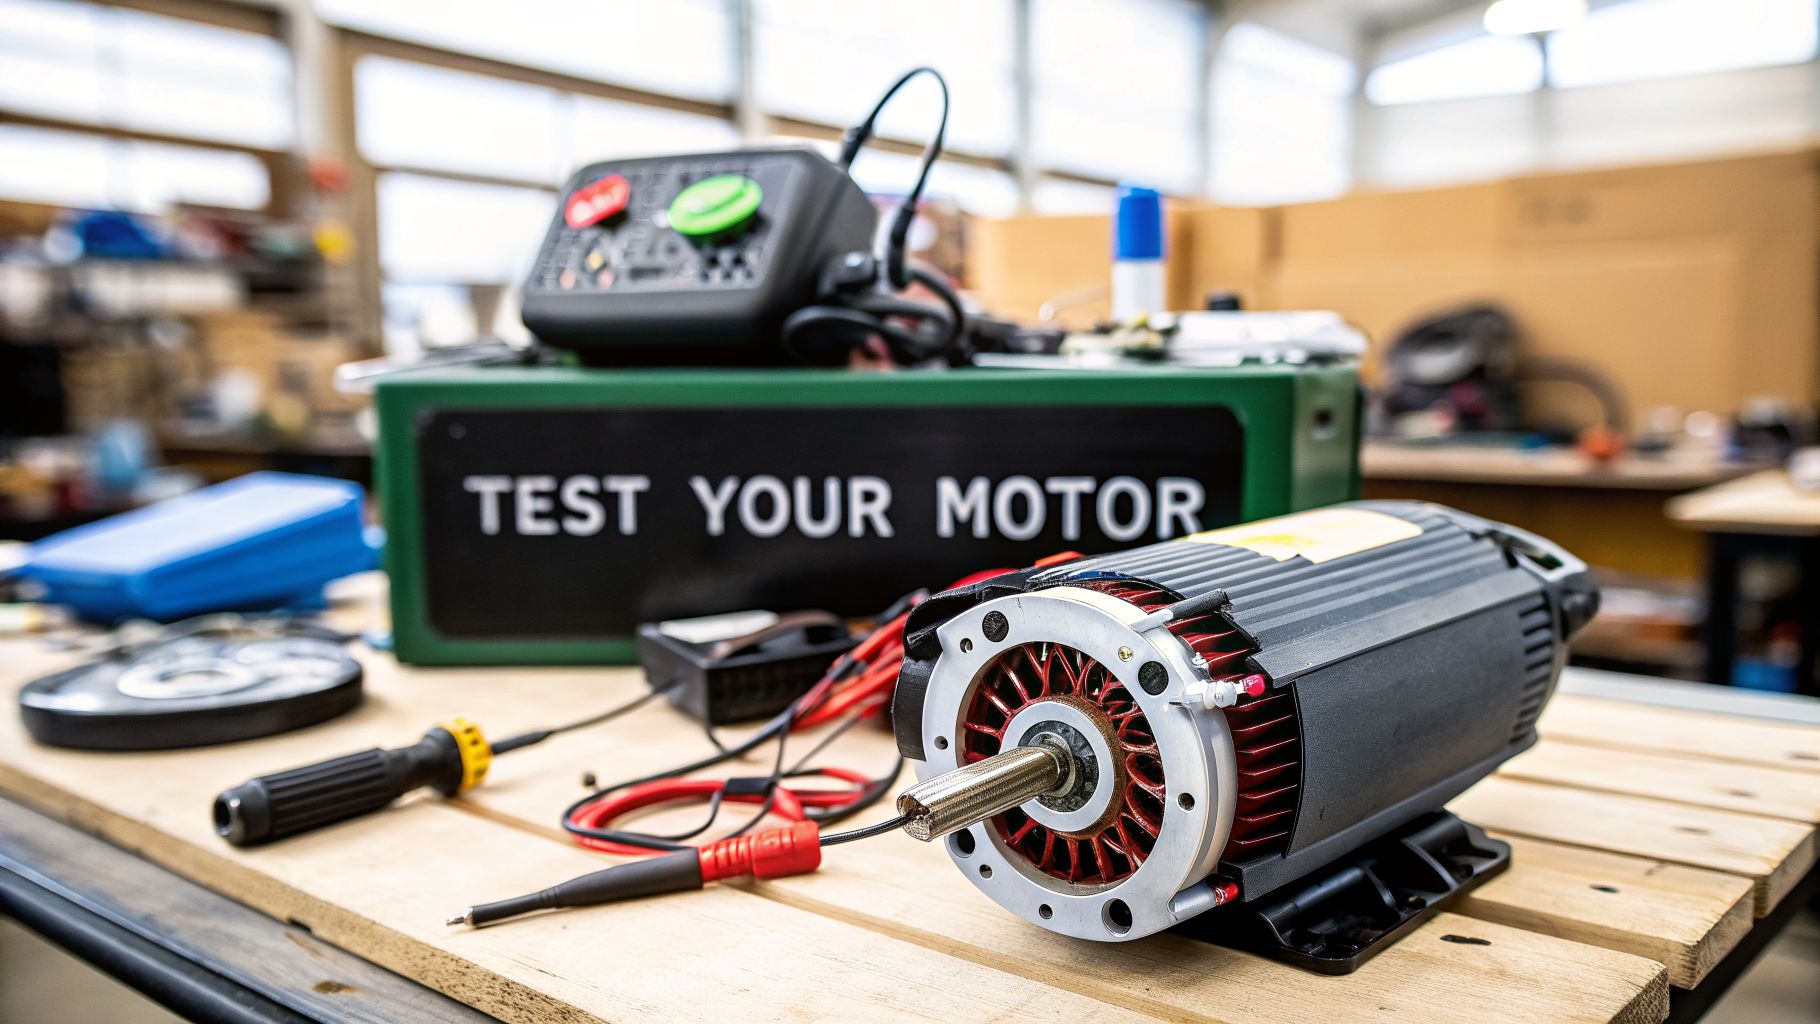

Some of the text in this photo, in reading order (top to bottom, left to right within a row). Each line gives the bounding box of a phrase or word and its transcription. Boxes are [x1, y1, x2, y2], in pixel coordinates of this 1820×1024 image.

[464, 475, 1205, 541] TEST YOUR MOTOR
